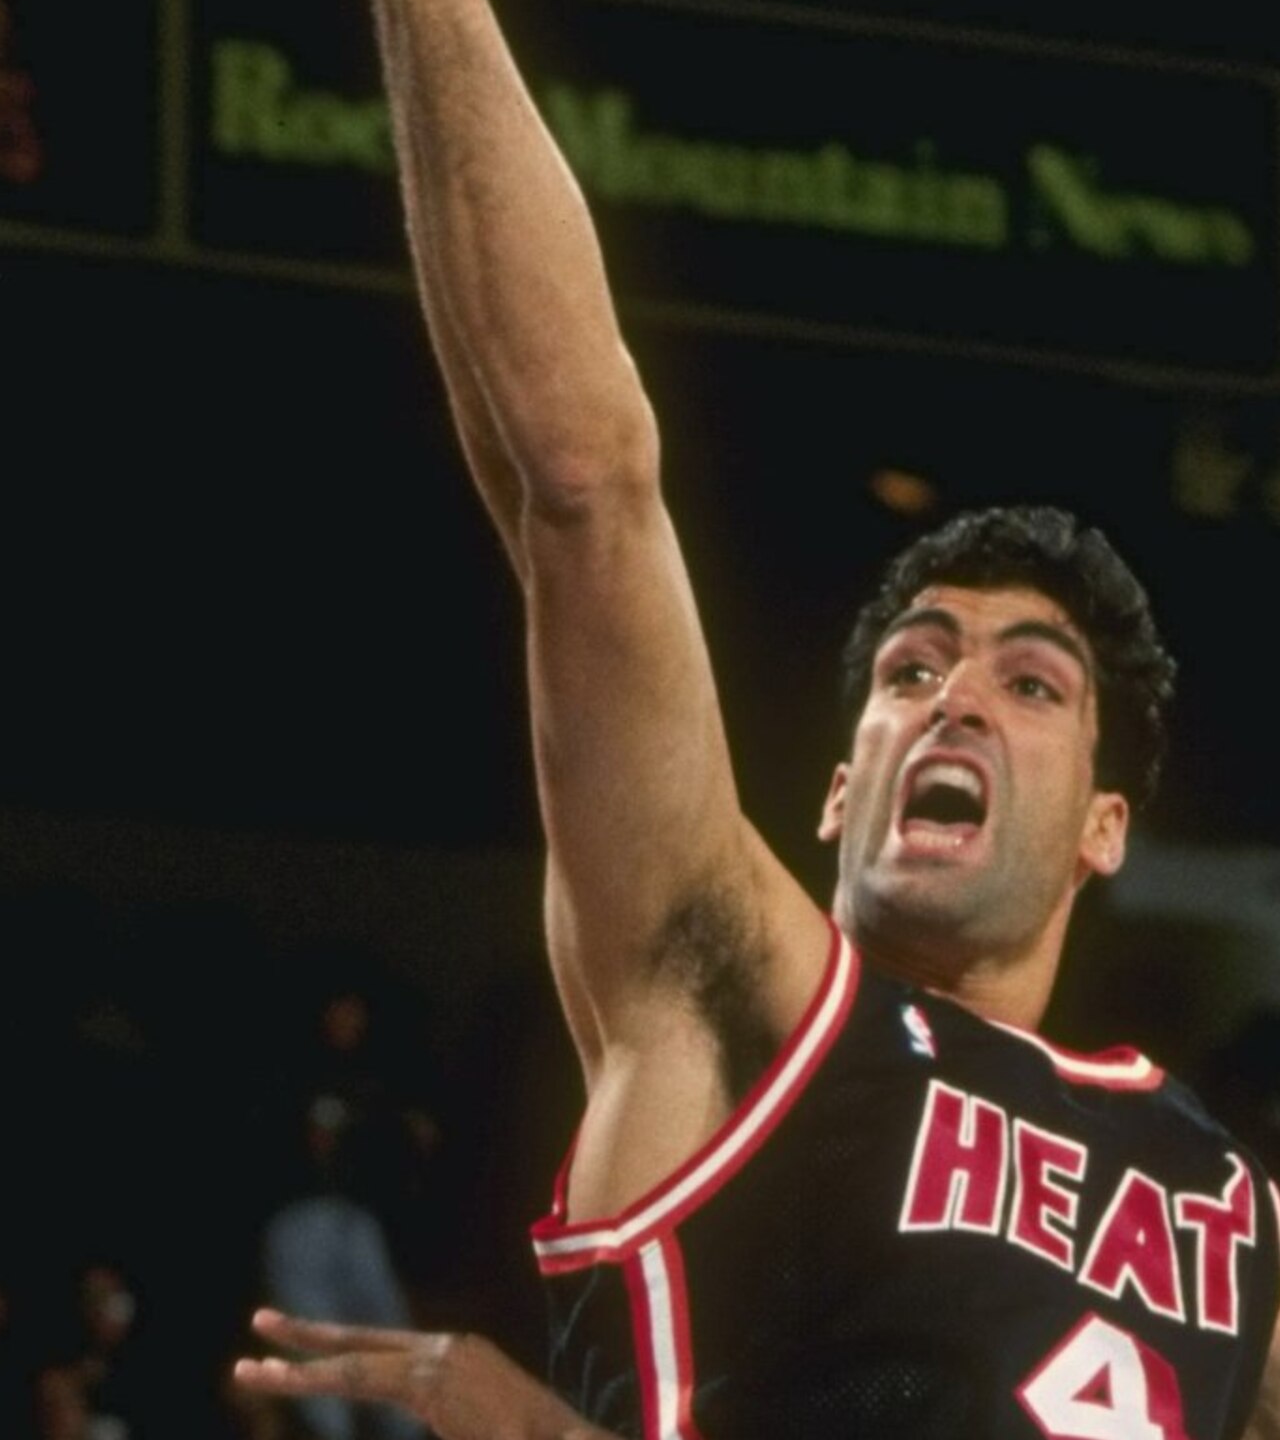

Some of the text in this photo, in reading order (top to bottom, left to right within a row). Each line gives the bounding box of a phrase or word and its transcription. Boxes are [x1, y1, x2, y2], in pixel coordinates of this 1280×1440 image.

[210, 36, 392, 168] Roc
[542, 76, 1008, 250] Mountain
[899, 1077, 1257, 1336] HEAT
